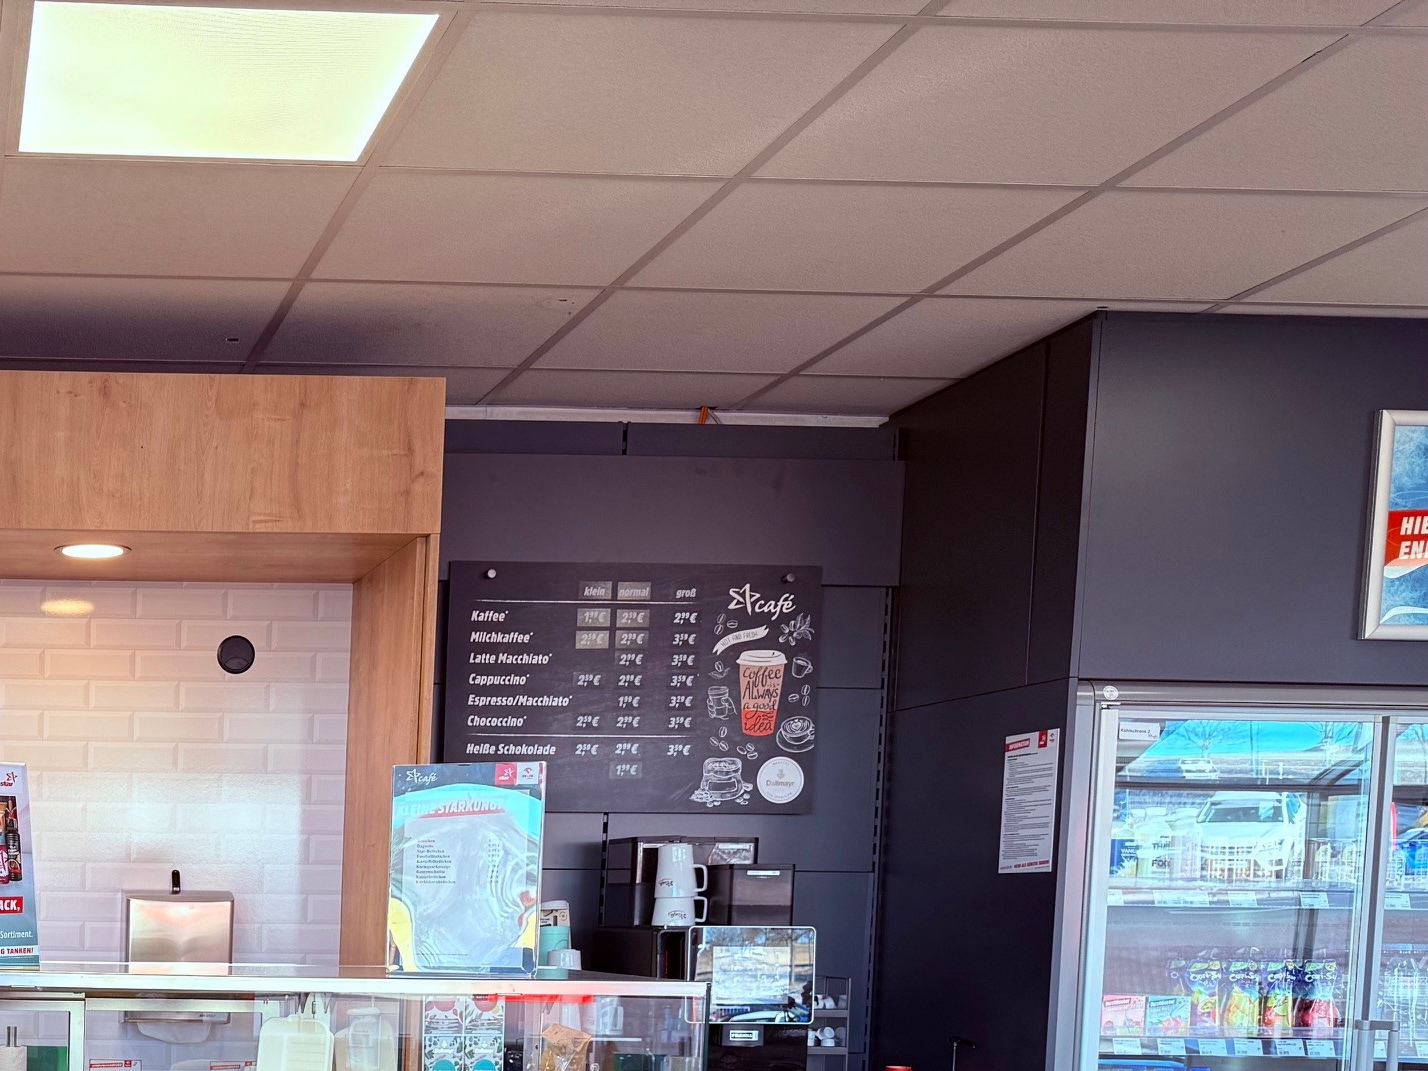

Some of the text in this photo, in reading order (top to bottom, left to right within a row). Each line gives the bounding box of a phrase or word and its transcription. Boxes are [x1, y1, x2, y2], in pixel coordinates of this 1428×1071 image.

[583, 586, 697, 599] klein normal groß
[755, 593, 796, 621] café
[469, 652, 496, 664] Latte
[466, 743, 496, 755] Heiße
[497, 743, 556, 755] Schokolade
[766, 780, 795, 788] Dallmayr
[6, 947, 34, 955] TANKEN!
